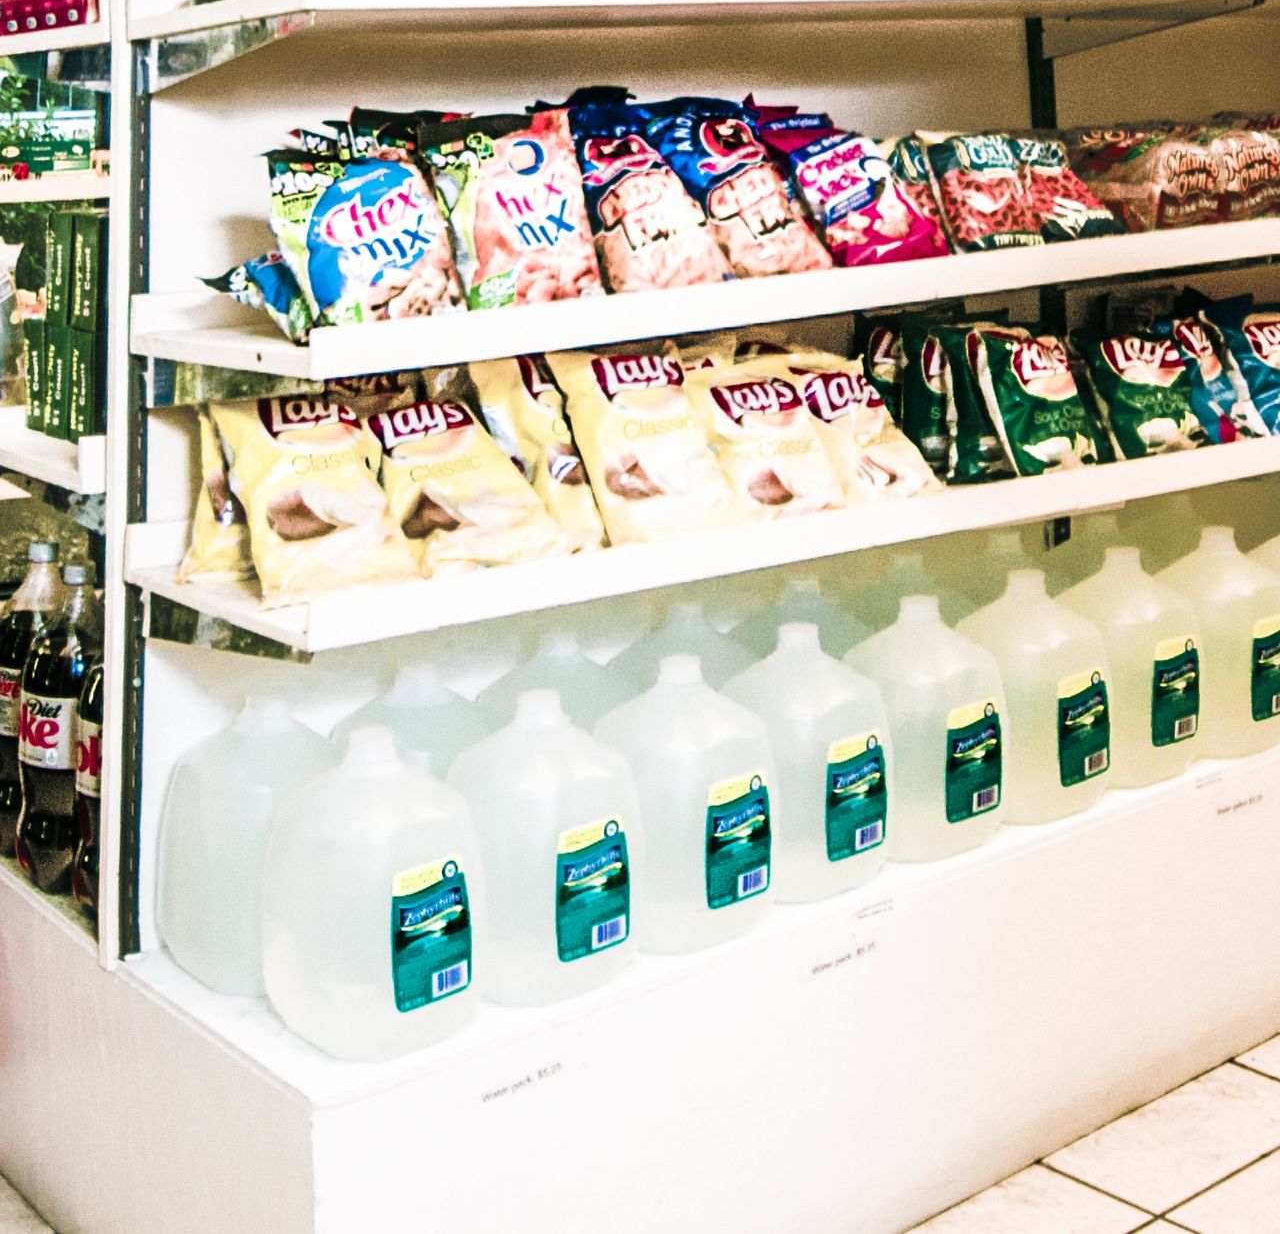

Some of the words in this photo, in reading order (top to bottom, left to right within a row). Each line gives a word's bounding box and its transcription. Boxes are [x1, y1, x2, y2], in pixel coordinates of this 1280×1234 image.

[325, 182, 419, 246] Chex
[623, 418, 696, 440] Classic
[758, 438, 819, 459] Classic
[409, 454, 482, 483] Classic
[27, 697, 62, 719] Diet
[20, 703, 60, 750] ke
[811, 961, 834, 975] Water
[835, 953, 852, 967] pack
[481, 1086, 509, 1103] Water
[511, 1076, 533, 1092] pack
[537, 1061, 563, 1079] $5.25
